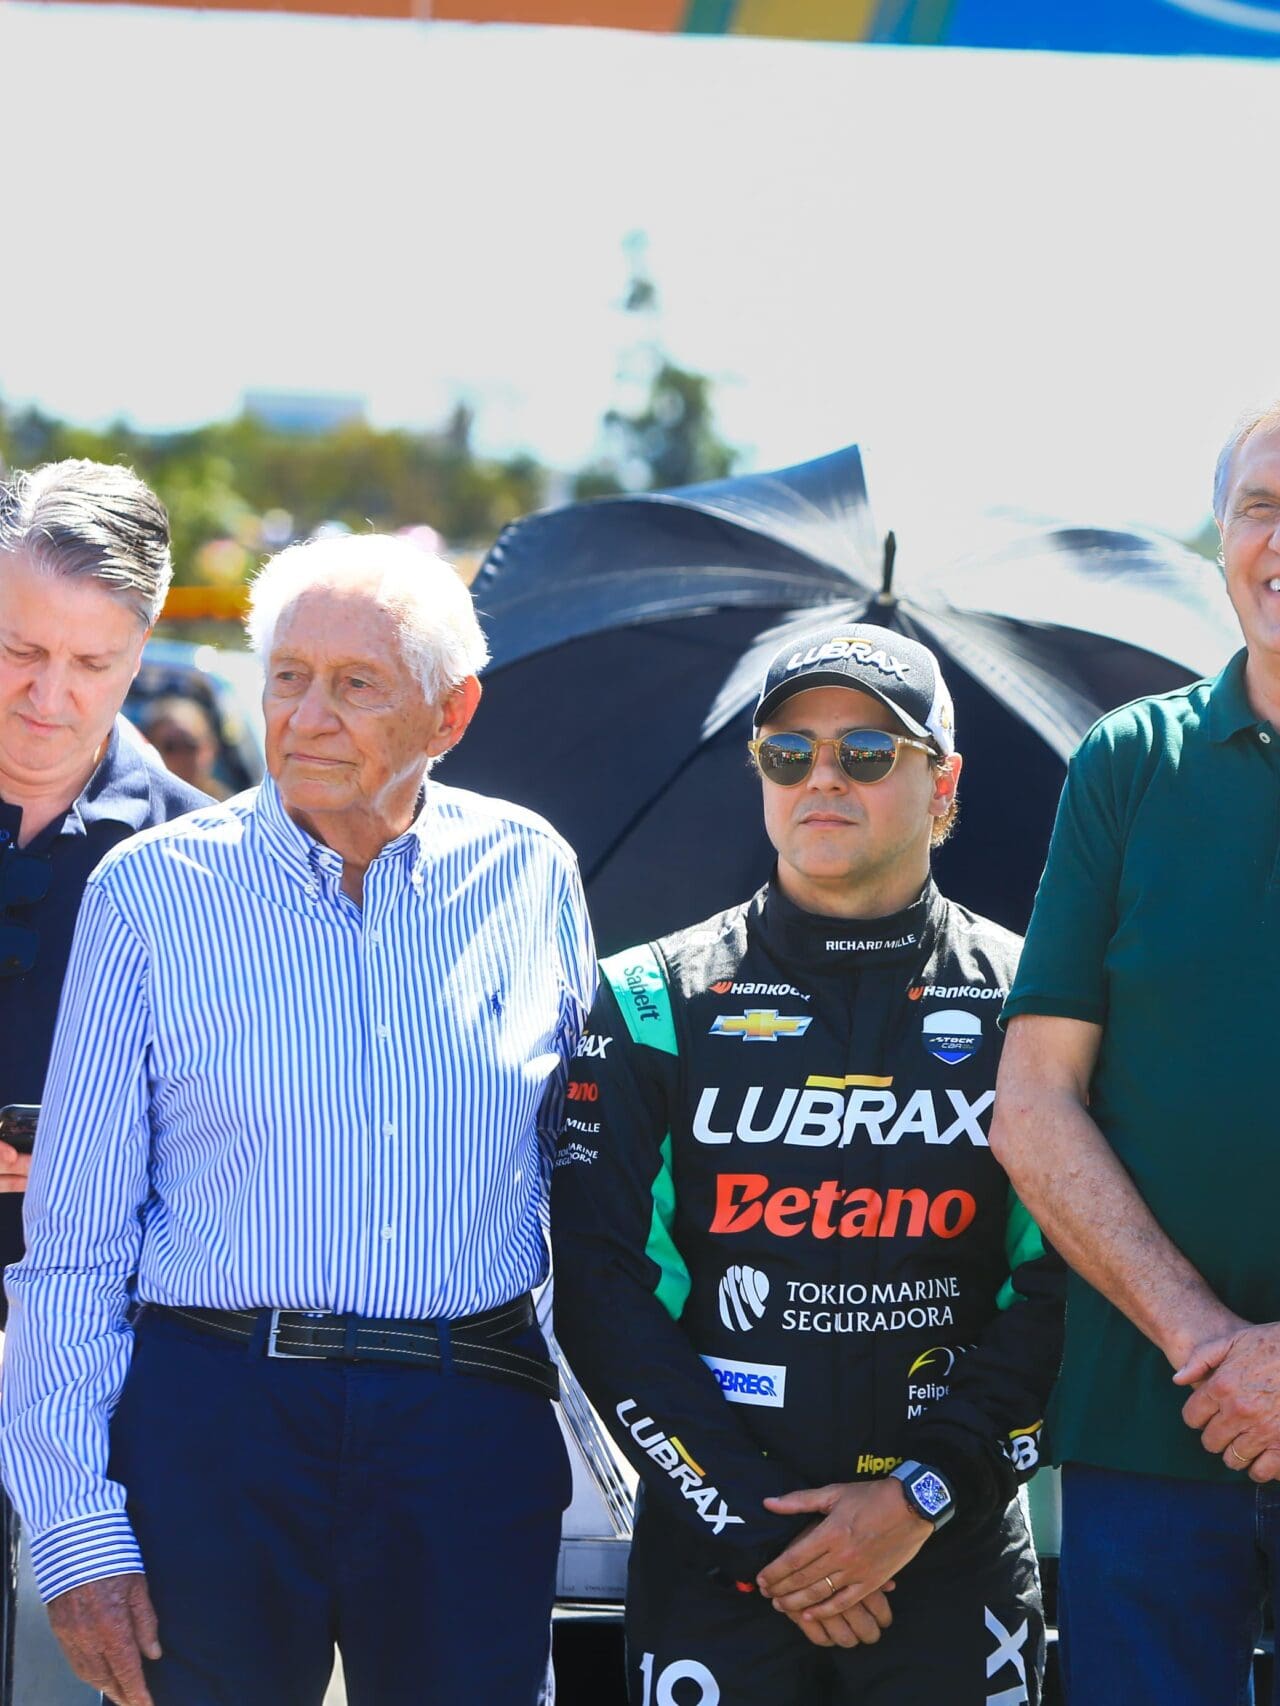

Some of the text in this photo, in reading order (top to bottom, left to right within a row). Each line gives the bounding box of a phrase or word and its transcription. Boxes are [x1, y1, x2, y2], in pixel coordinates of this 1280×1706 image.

[786, 641, 910, 684] LUBRAX
[825, 933, 917, 951] RICHARD MILLE
[624, 965, 661, 1021] Sabelt
[692, 1087, 996, 1149] LUBRAX
[709, 1173, 976, 1239] Betano
[786, 1277, 960, 1304] TOKIO MARINE
[782, 1306, 954, 1332] SEGURADORA
[616, 1398, 745, 1535] LUBRAX
